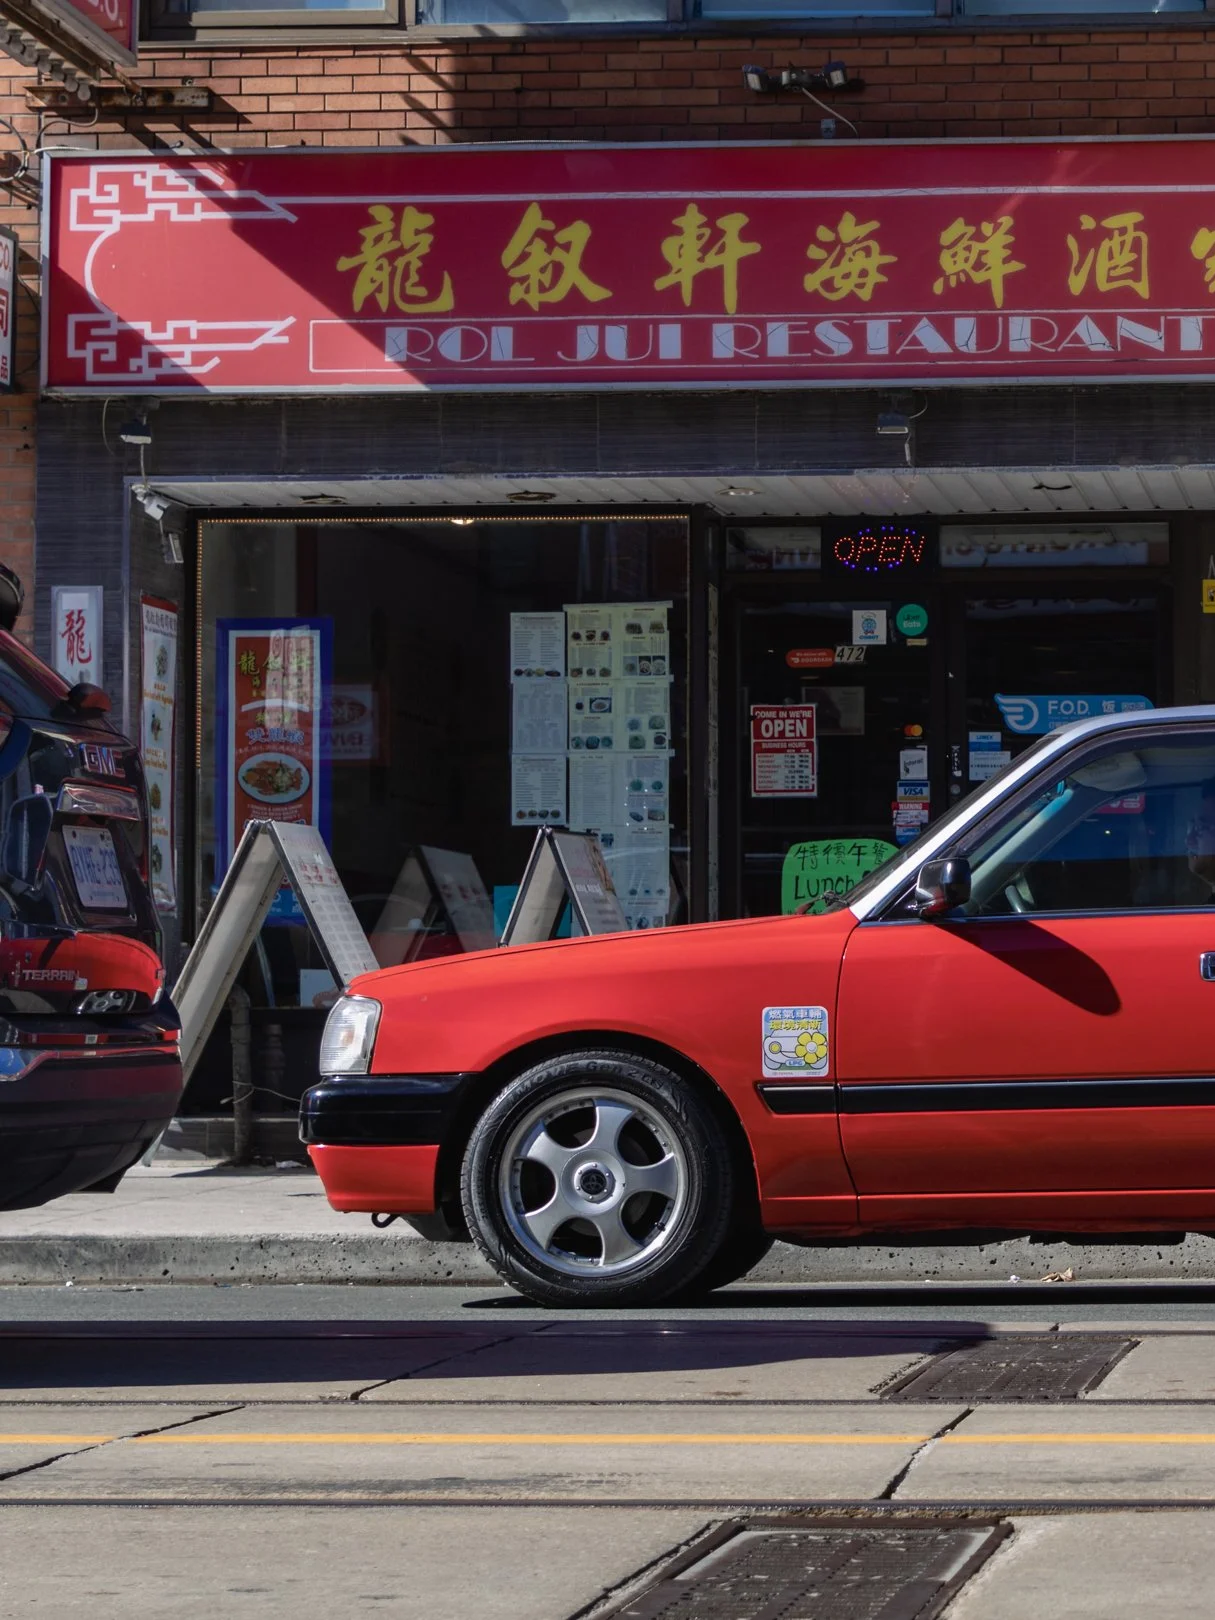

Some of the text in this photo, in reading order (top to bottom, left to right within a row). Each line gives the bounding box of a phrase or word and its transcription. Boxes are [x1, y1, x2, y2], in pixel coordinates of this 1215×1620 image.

[385, 315, 1215, 363] ROL JUI RESTAURANT
[834, 535, 926, 564] OPEN
[61, 608, 92, 665] 龍
[836, 647, 865, 660] 472
[761, 719, 807, 738] OPEN
[904, 787, 923, 796] VISA
[795, 875, 855, 900] Lunch
[22, 969, 80, 981] TERRAIN
